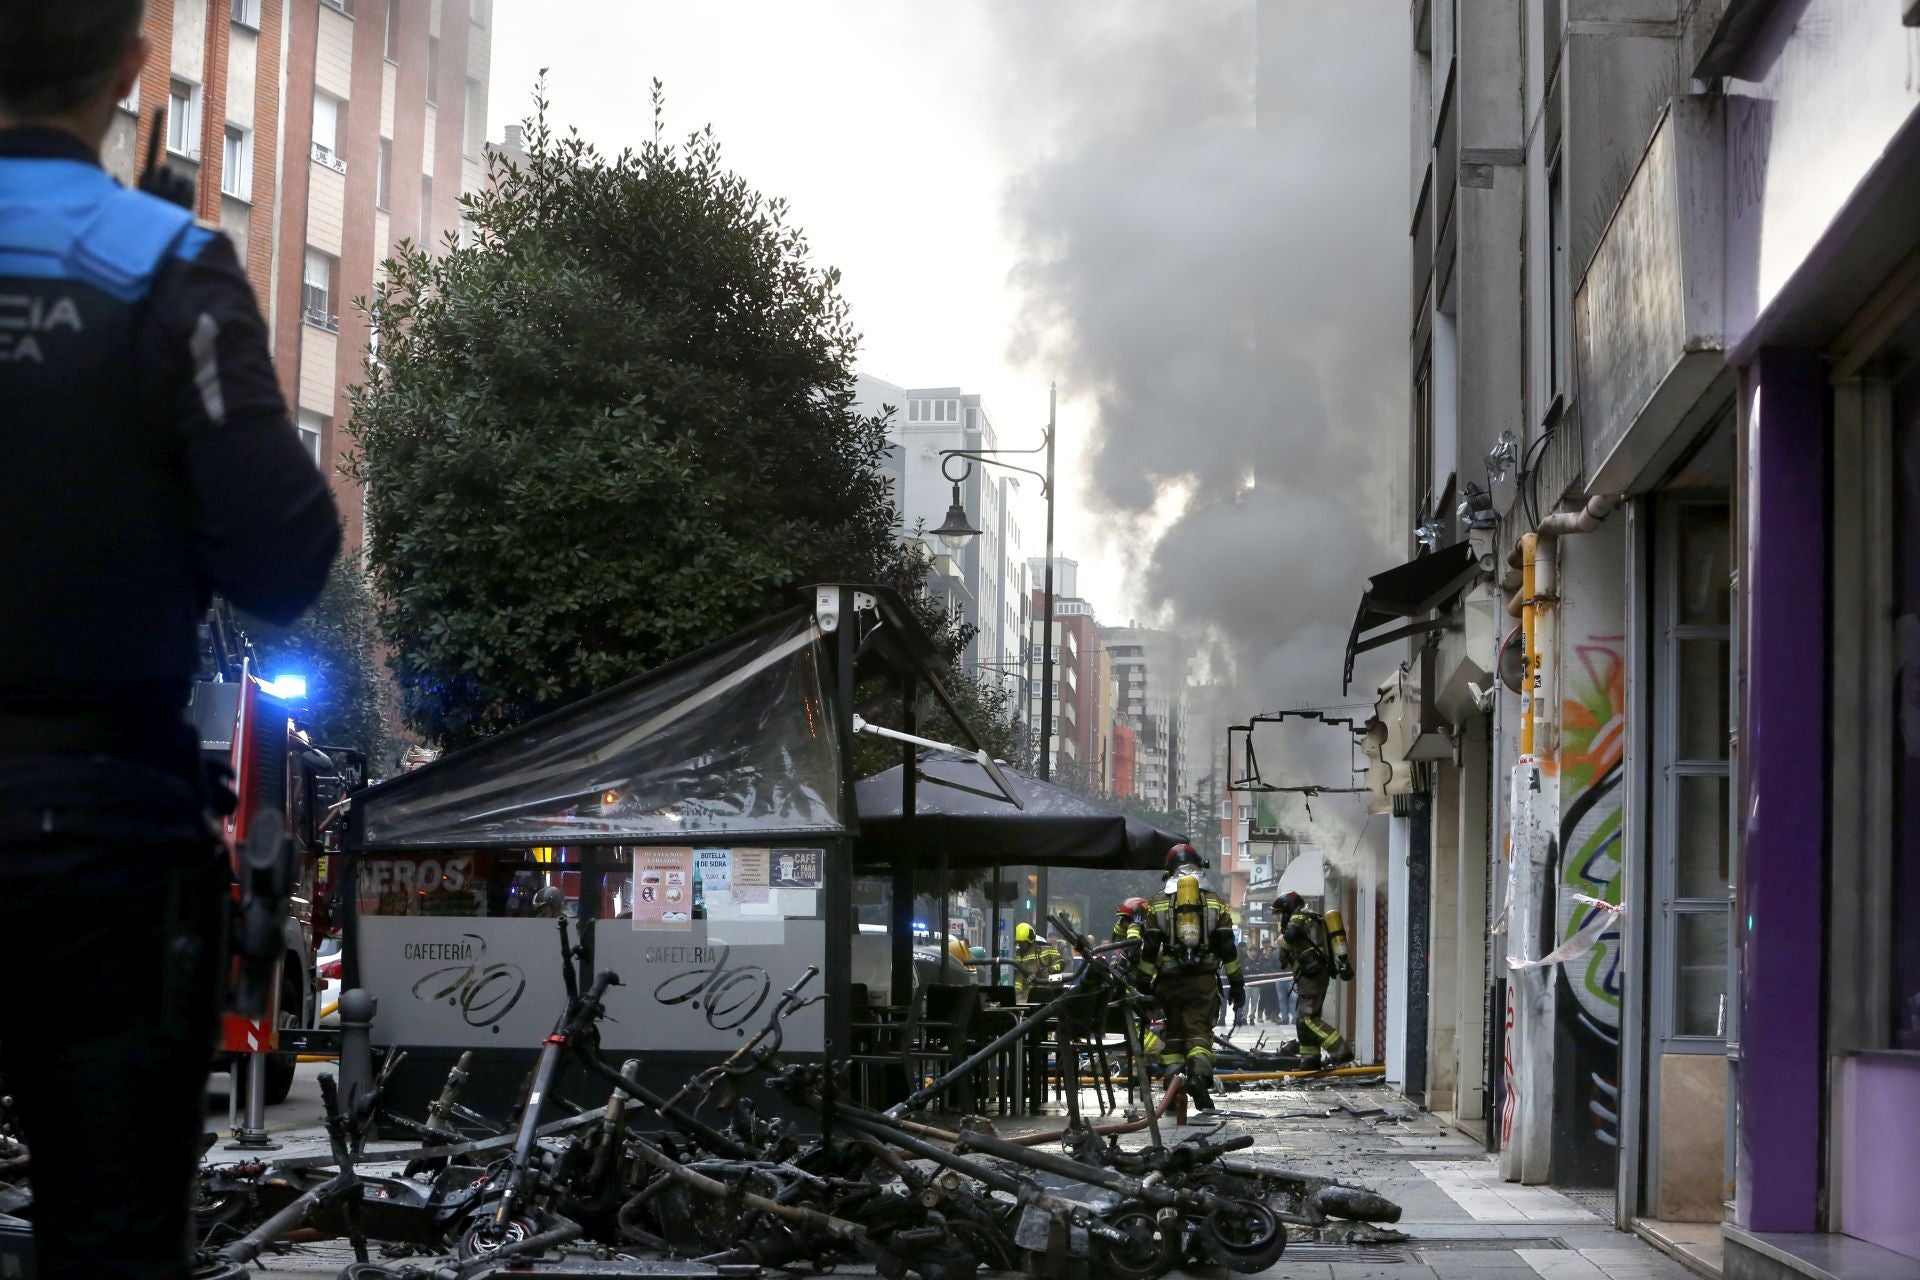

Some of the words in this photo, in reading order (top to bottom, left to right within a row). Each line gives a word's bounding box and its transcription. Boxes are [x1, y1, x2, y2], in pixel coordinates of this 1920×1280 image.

[794, 851, 817, 864] CAFÉ
[800, 864, 816, 872] PARA
[793, 871, 816, 880] LLEVAR
[404, 940, 473, 960] CAFETERÍA
